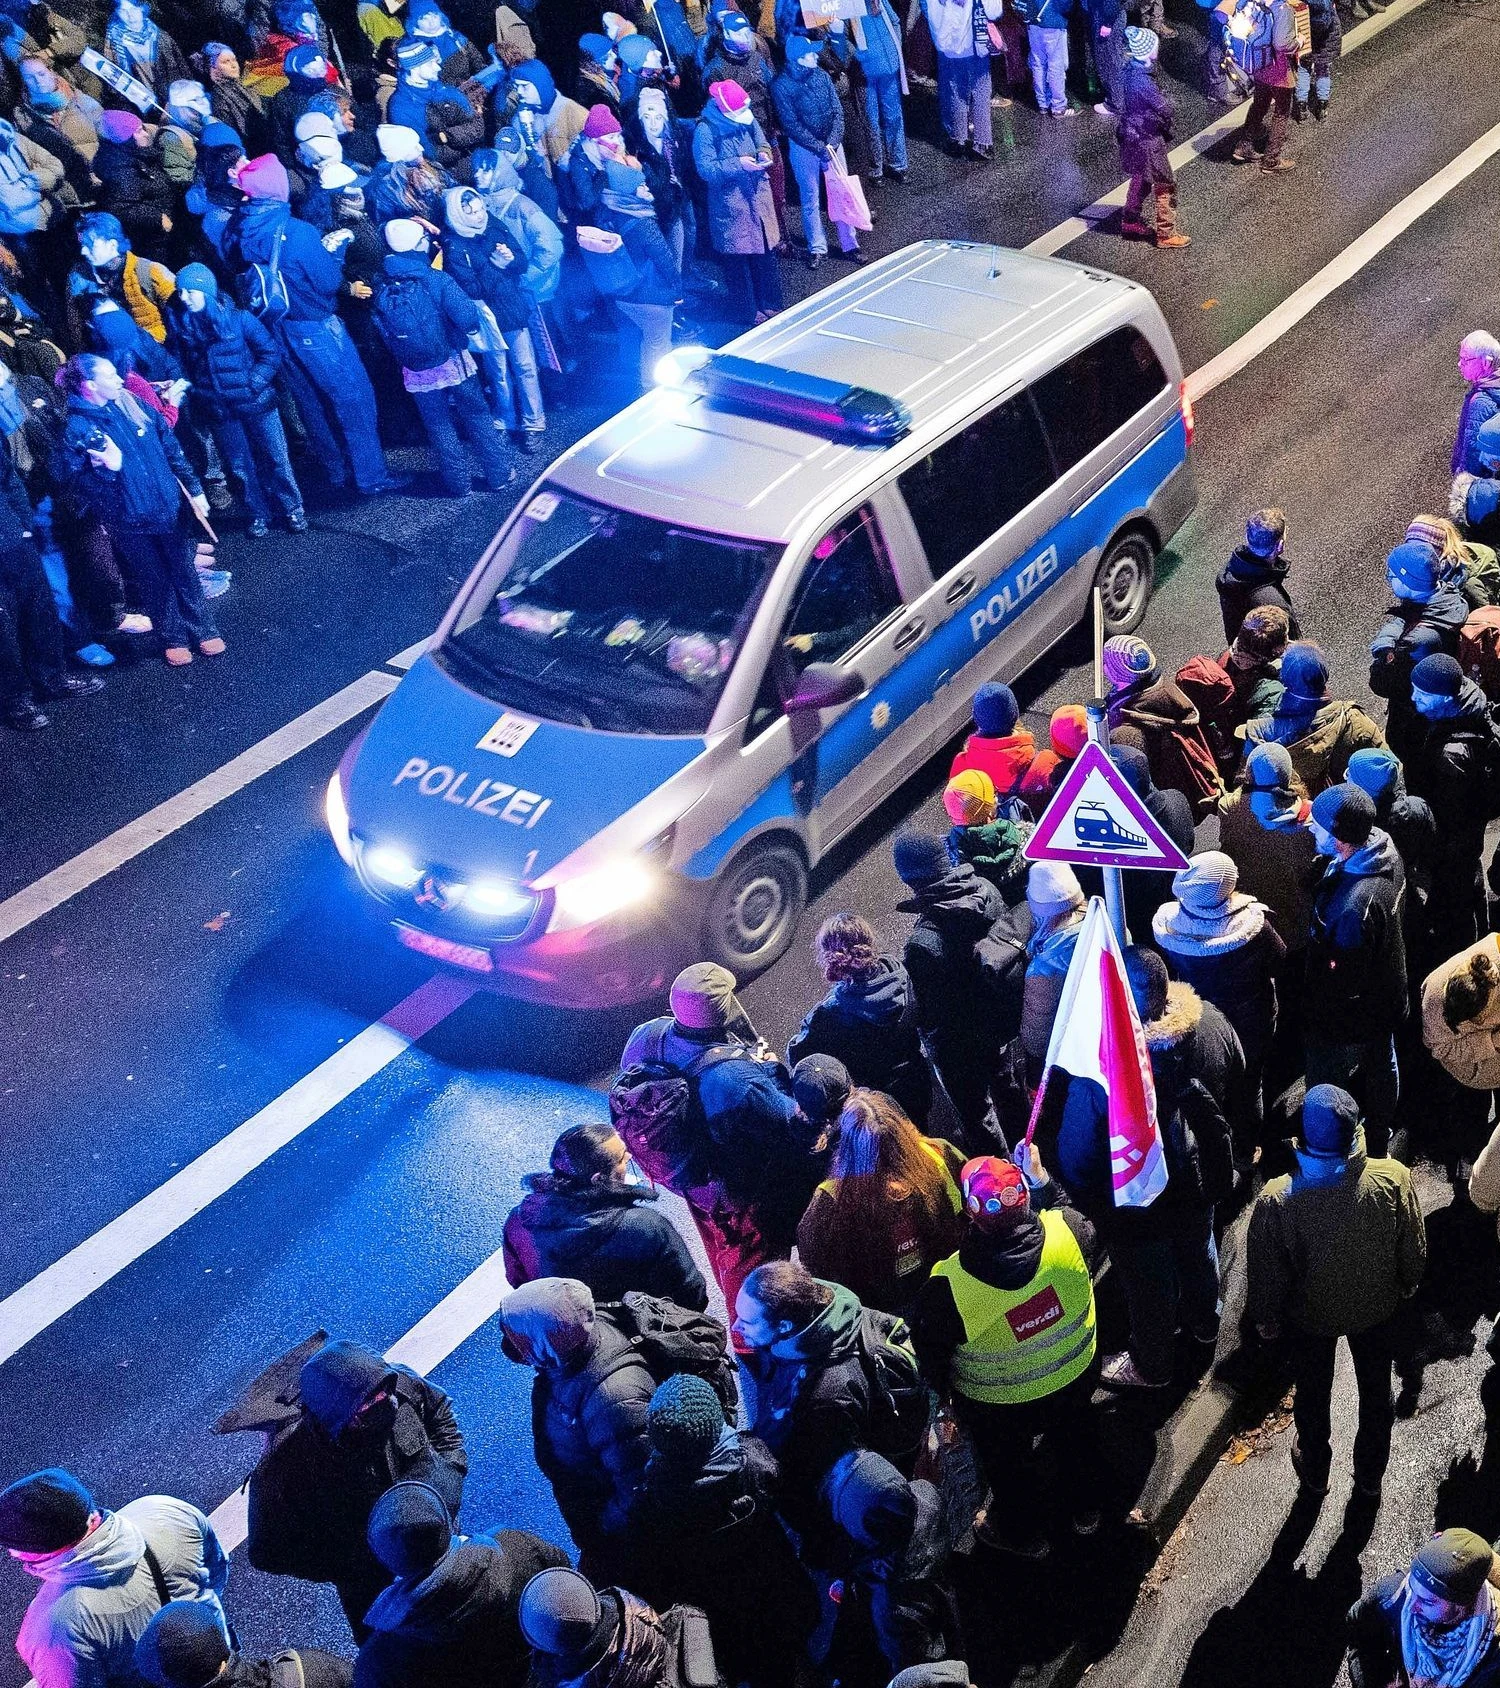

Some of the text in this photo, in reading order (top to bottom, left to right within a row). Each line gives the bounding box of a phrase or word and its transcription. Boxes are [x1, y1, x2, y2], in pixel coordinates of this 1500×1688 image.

[970, 543, 1058, 643] POLIZEI
[392, 757, 553, 830] POLIZEI
[1015, 1306, 1060, 1334] ver.di
